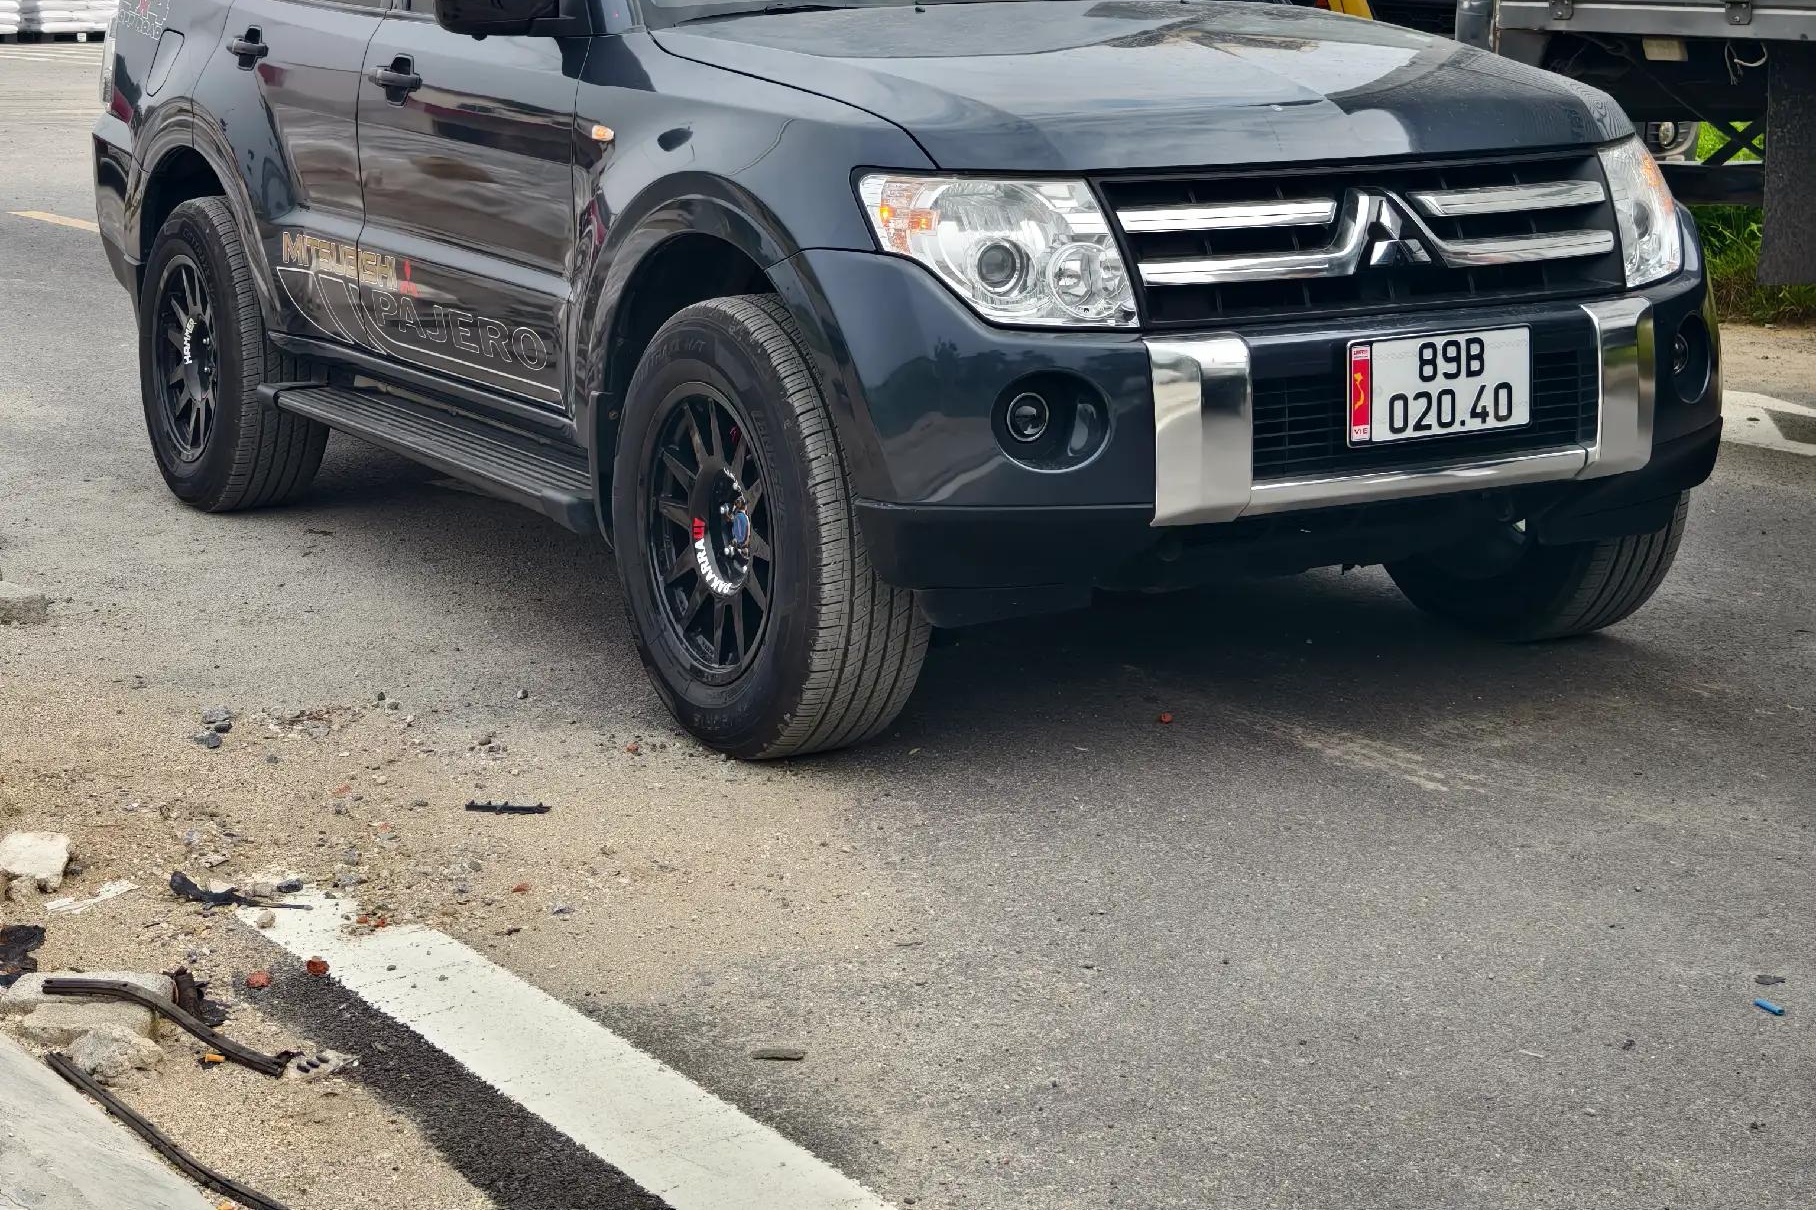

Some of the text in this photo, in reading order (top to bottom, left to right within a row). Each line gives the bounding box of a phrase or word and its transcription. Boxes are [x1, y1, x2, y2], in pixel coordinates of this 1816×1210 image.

[282, 231, 398, 291] MITSUBISHI
[373, 290, 548, 371] PAJERO
[1418, 337, 1485, 382] 89B
[1388, 382, 1513, 435] 020.40
